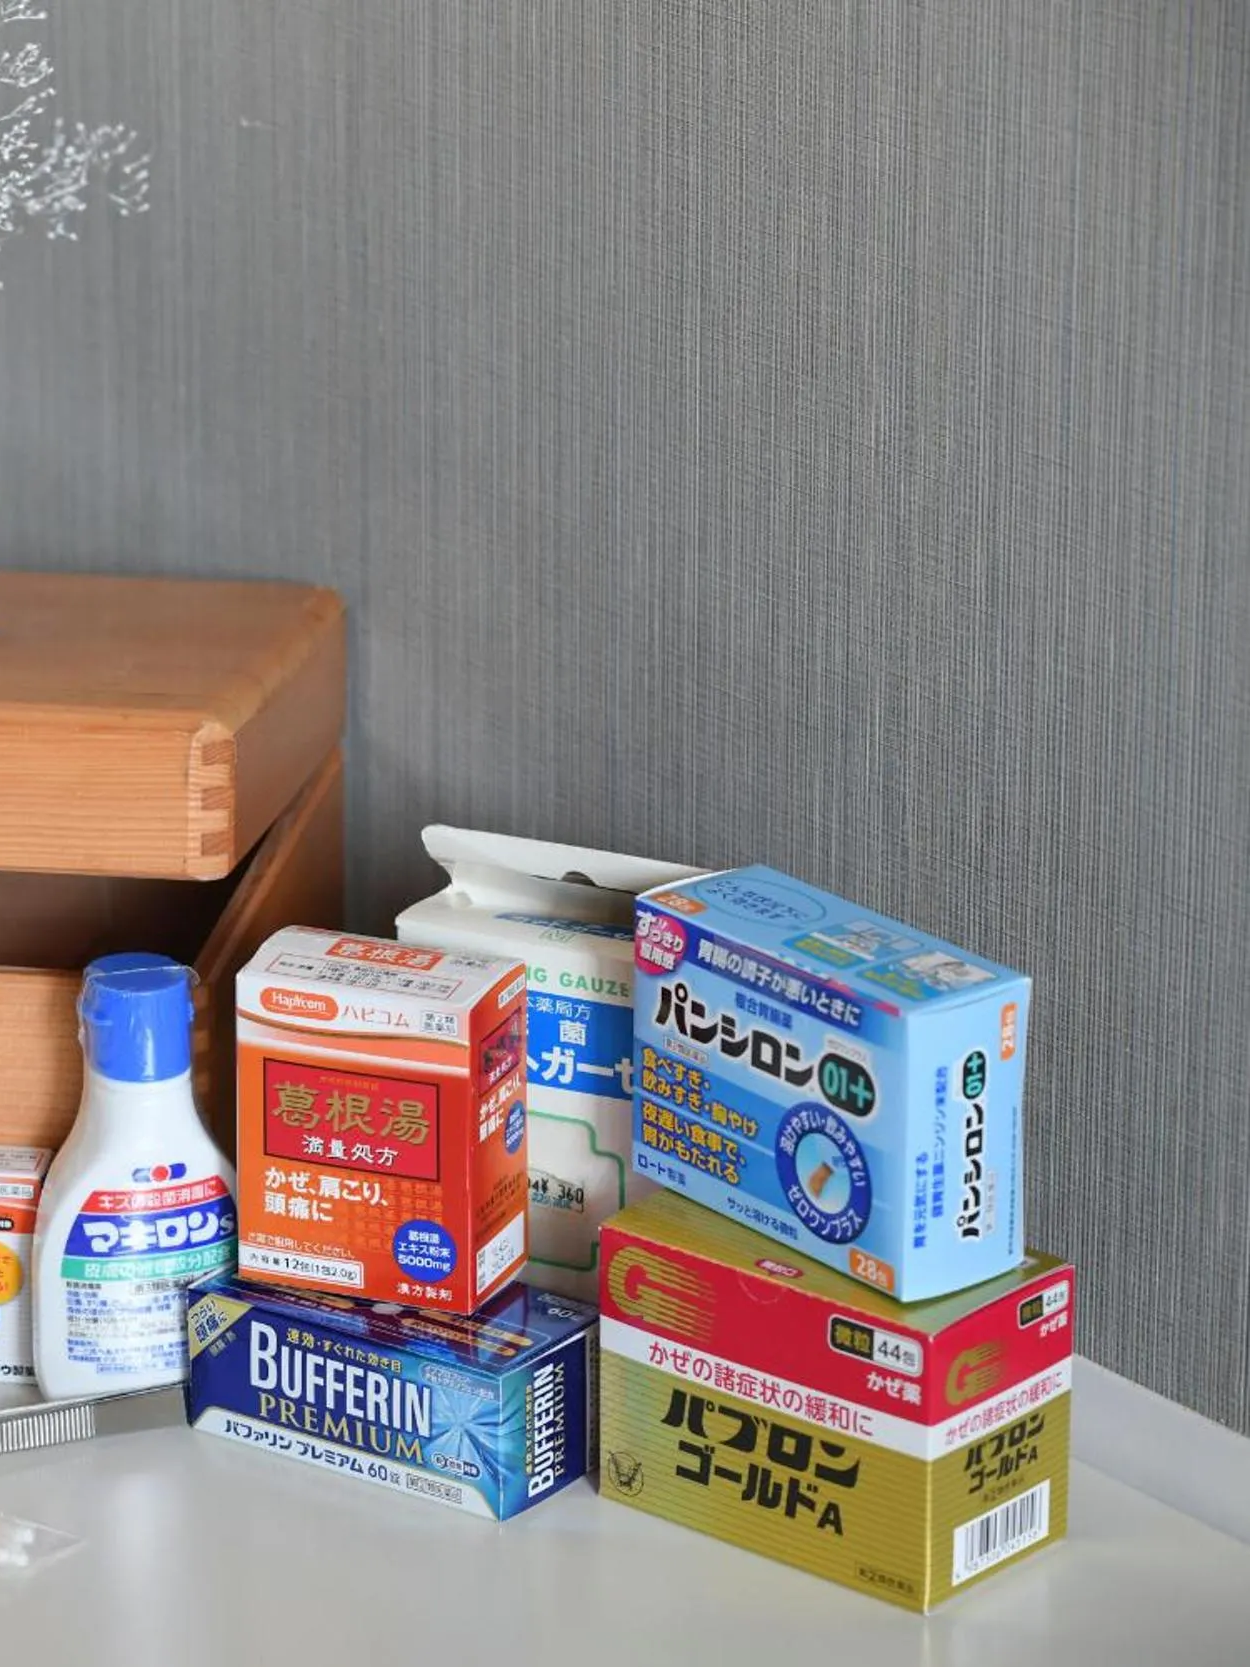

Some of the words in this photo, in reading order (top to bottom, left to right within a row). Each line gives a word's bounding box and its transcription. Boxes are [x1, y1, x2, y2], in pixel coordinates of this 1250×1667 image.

[559, 971, 630, 998] GAUZE
[698, 939, 861, 1027] 胃腸の調子が悪いときに
[342, 1005, 410, 1028] ハピコム
[655, 983, 814, 1088] パンシロン
[823, 1061, 874, 1109] 01+
[643, 1070, 759, 1136] 飲みすぎ・胸やけ
[964, 1052, 984, 1097] 01+
[272, 1081, 431, 1145] 葛根湯
[643, 1100, 747, 1165] 夜遅い食事で、
[302, 1134, 399, 1167] 満量処方
[643, 1124, 740, 1185] 胃がもたれる
[956, 1102, 985, 1239] パンシロン
[263, 1191, 334, 1222] 頭痛に
[264, 1166, 389, 1207] かぜ、肩こり、
[787, 1184, 863, 1240] ゼロワンプラス
[397, 1282, 453, 1302] 漢方製剤
[855, 1254, 889, 1289] 28包
[250, 1320, 432, 1438] BUFFERIN
[285, 1327, 402, 1373] 速効・すぐれた効き目
[877, 1340, 919, 1368] 44包
[649, 1342, 874, 1437] かぜの諸症状の緩和に
[865, 1371, 923, 1405] かぜ薬
[945, 1371, 1064, 1446] かぜの諸症状の緩和に
[225, 1418, 293, 1450] バファリン
[296, 1440, 364, 1475] プレミアム
[259, 1392, 424, 1465] PREMIUM
[528, 1362, 555, 1498] BUFFERIN
[554, 1361, 565, 1477] PREMIUM
[660, 1388, 861, 1488] パブロン
[964, 1412, 1046, 1471] パブロン
[675, 1439, 844, 1536] ゴールドA
[968, 1443, 1039, 1494] ゴールドA
